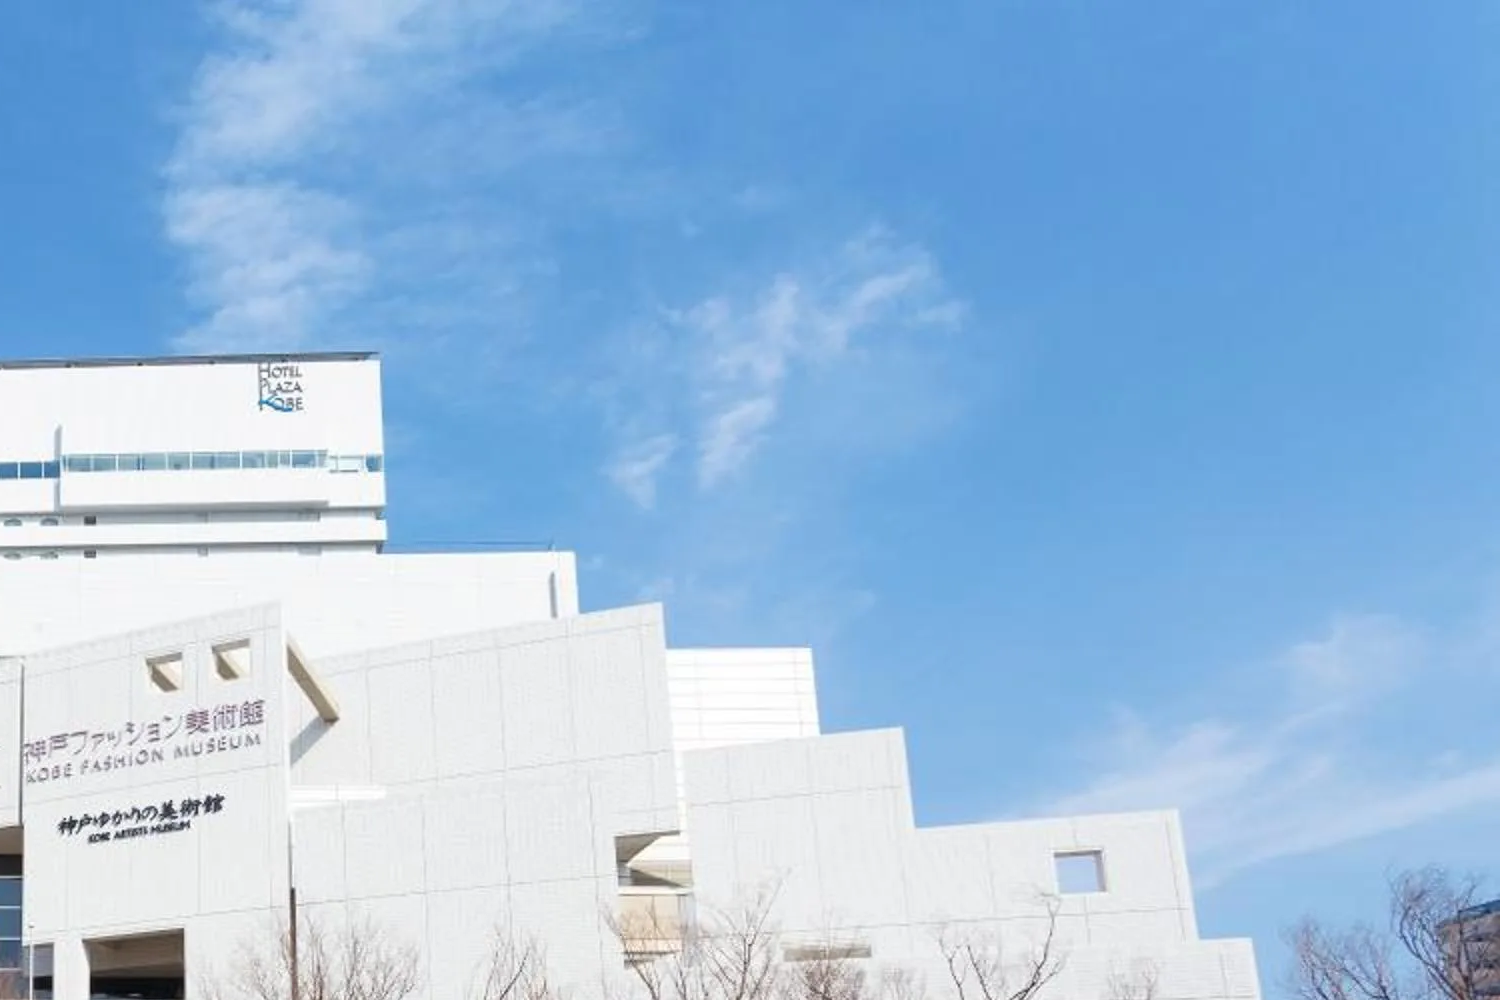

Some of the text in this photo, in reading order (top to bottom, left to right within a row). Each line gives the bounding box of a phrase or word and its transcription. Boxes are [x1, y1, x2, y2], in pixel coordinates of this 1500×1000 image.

[258, 362, 303, 378] HOTEL
[259, 377, 303, 393] PLAZA
[258, 394, 304, 412] KOBE
[23, 699, 265, 764] 神戸ファッション美術館
[26, 733, 261, 784] KOBE FASHION MUSEUM
[58, 793, 225, 835] 神戸ゆかりの美術館
